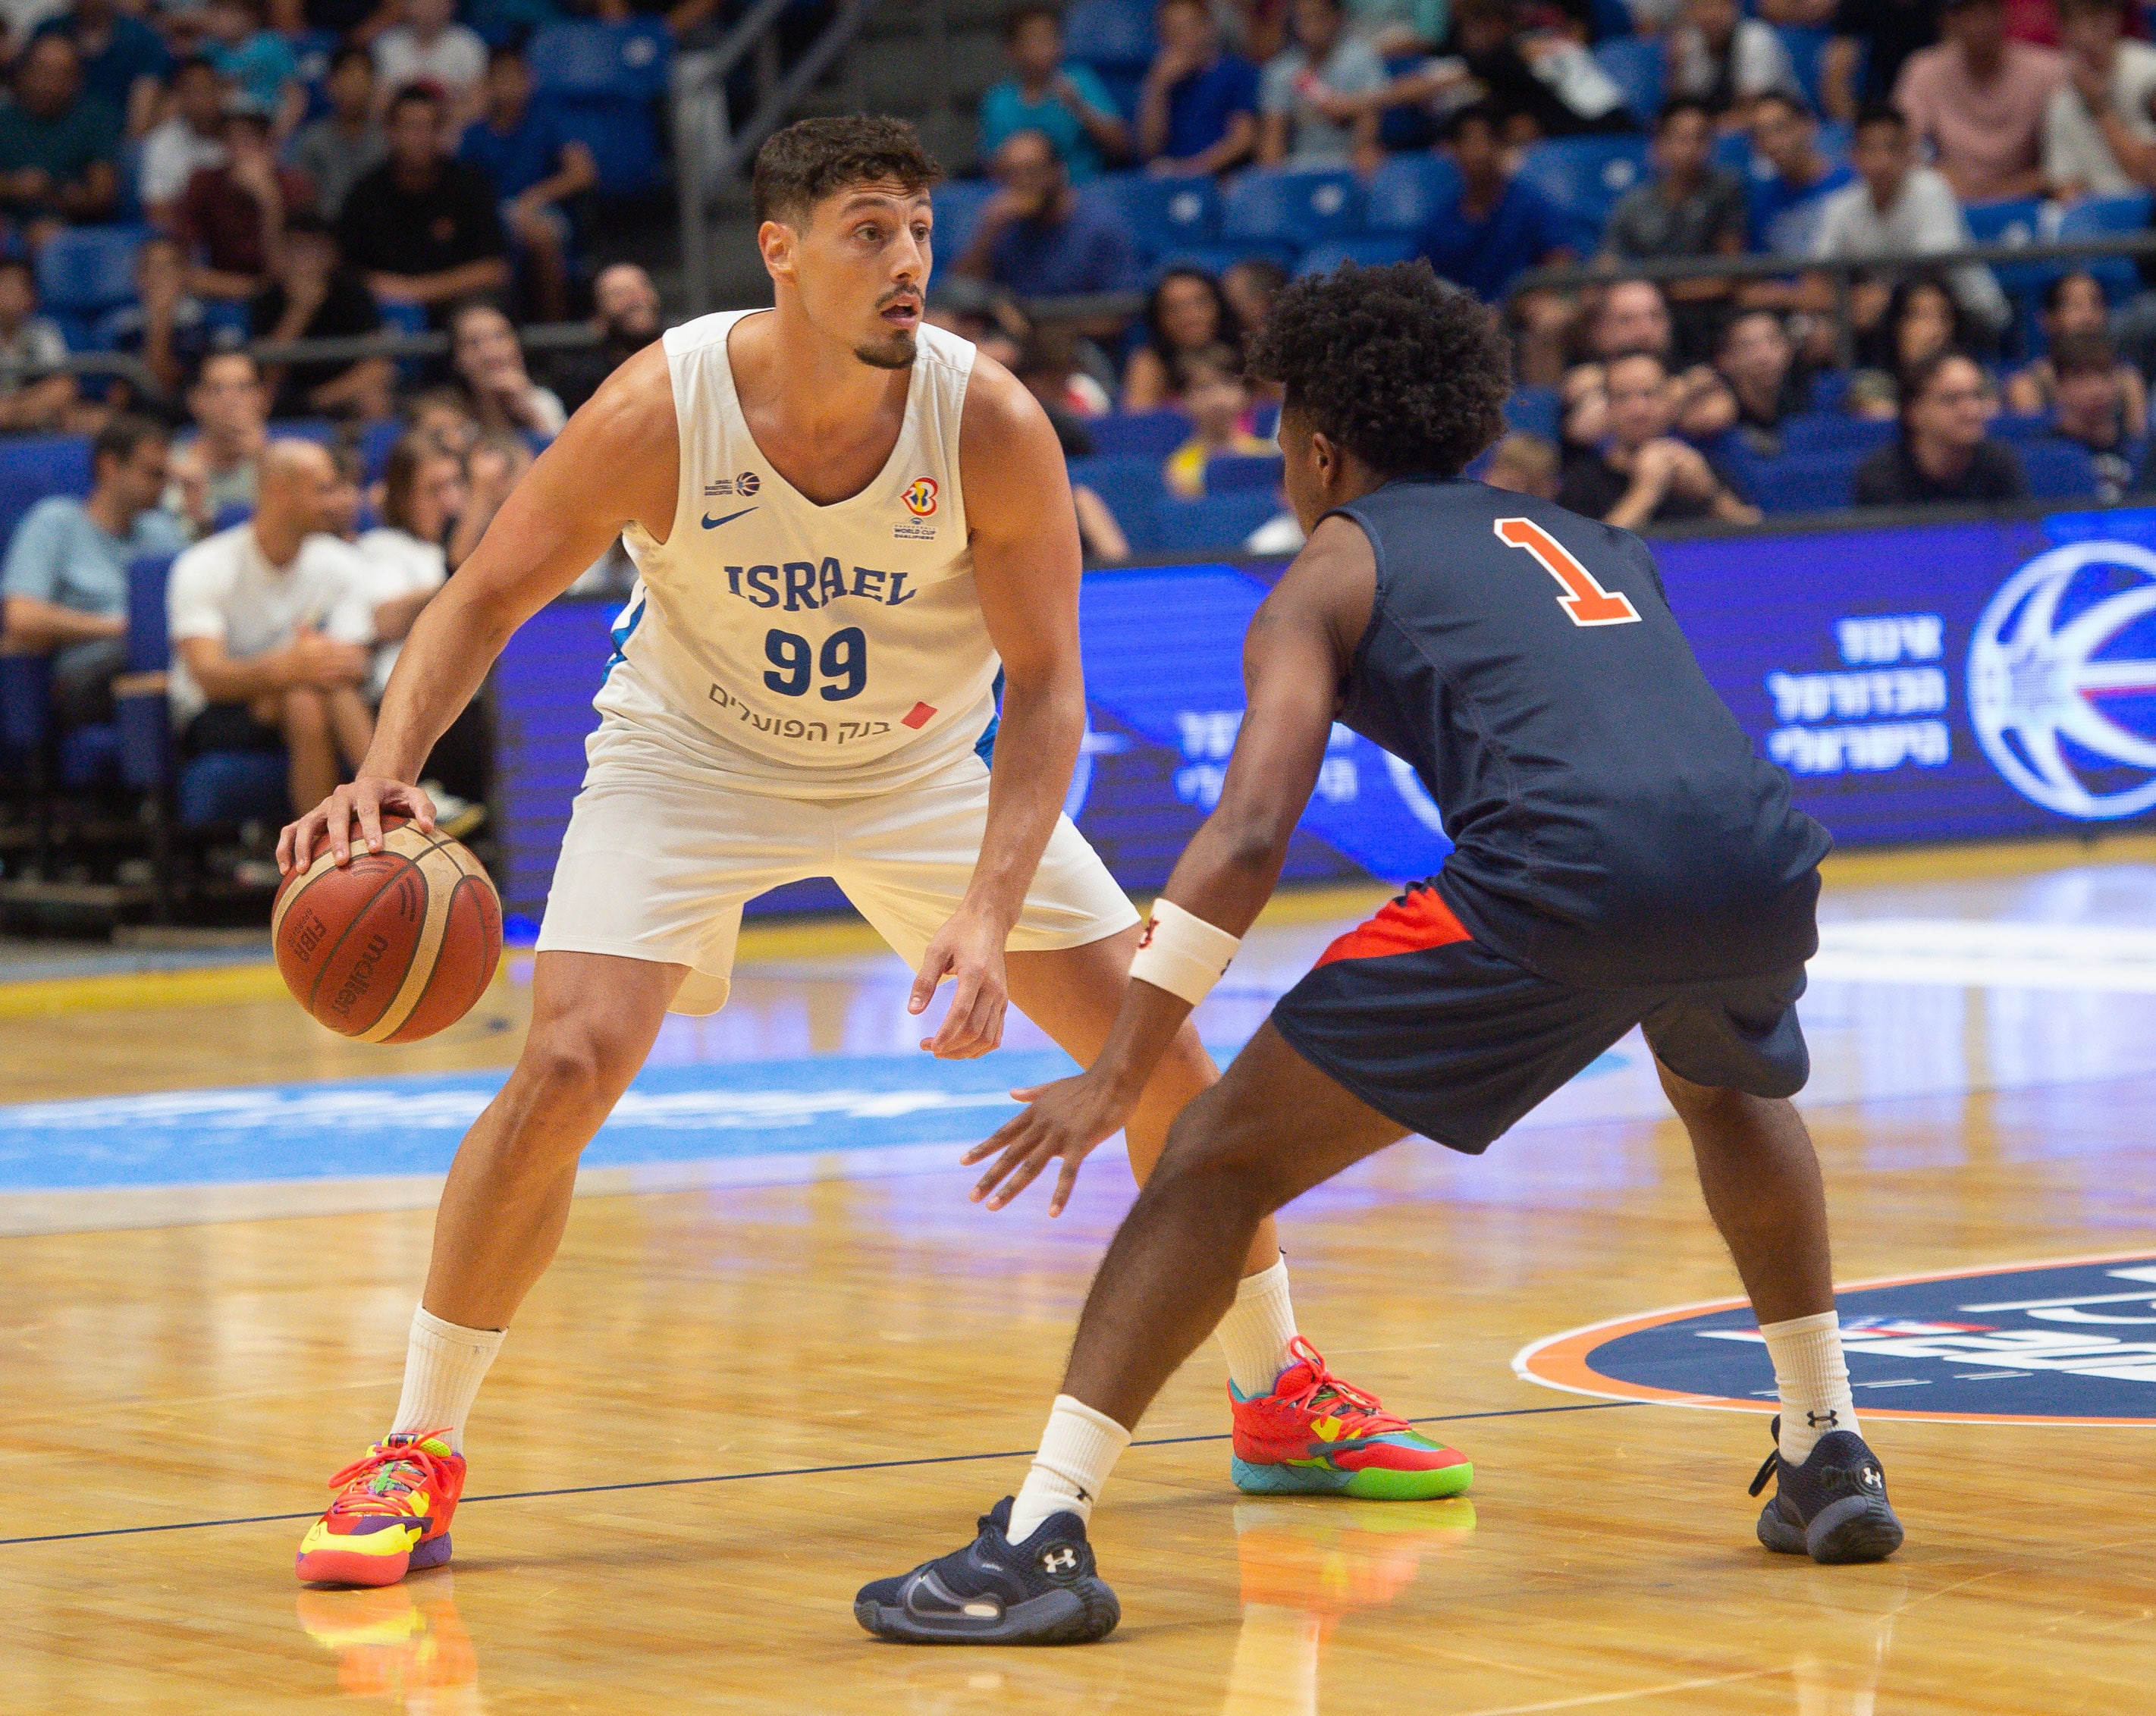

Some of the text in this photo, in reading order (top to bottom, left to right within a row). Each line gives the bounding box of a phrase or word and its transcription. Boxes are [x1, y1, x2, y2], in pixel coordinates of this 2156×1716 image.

[724, 557, 917, 611] ISRAEL
[1494, 517, 1643, 627] 1
[763, 626, 868, 701] 99
[838, 721, 891, 744] בנק
[293, 915, 327, 963] FIBA
